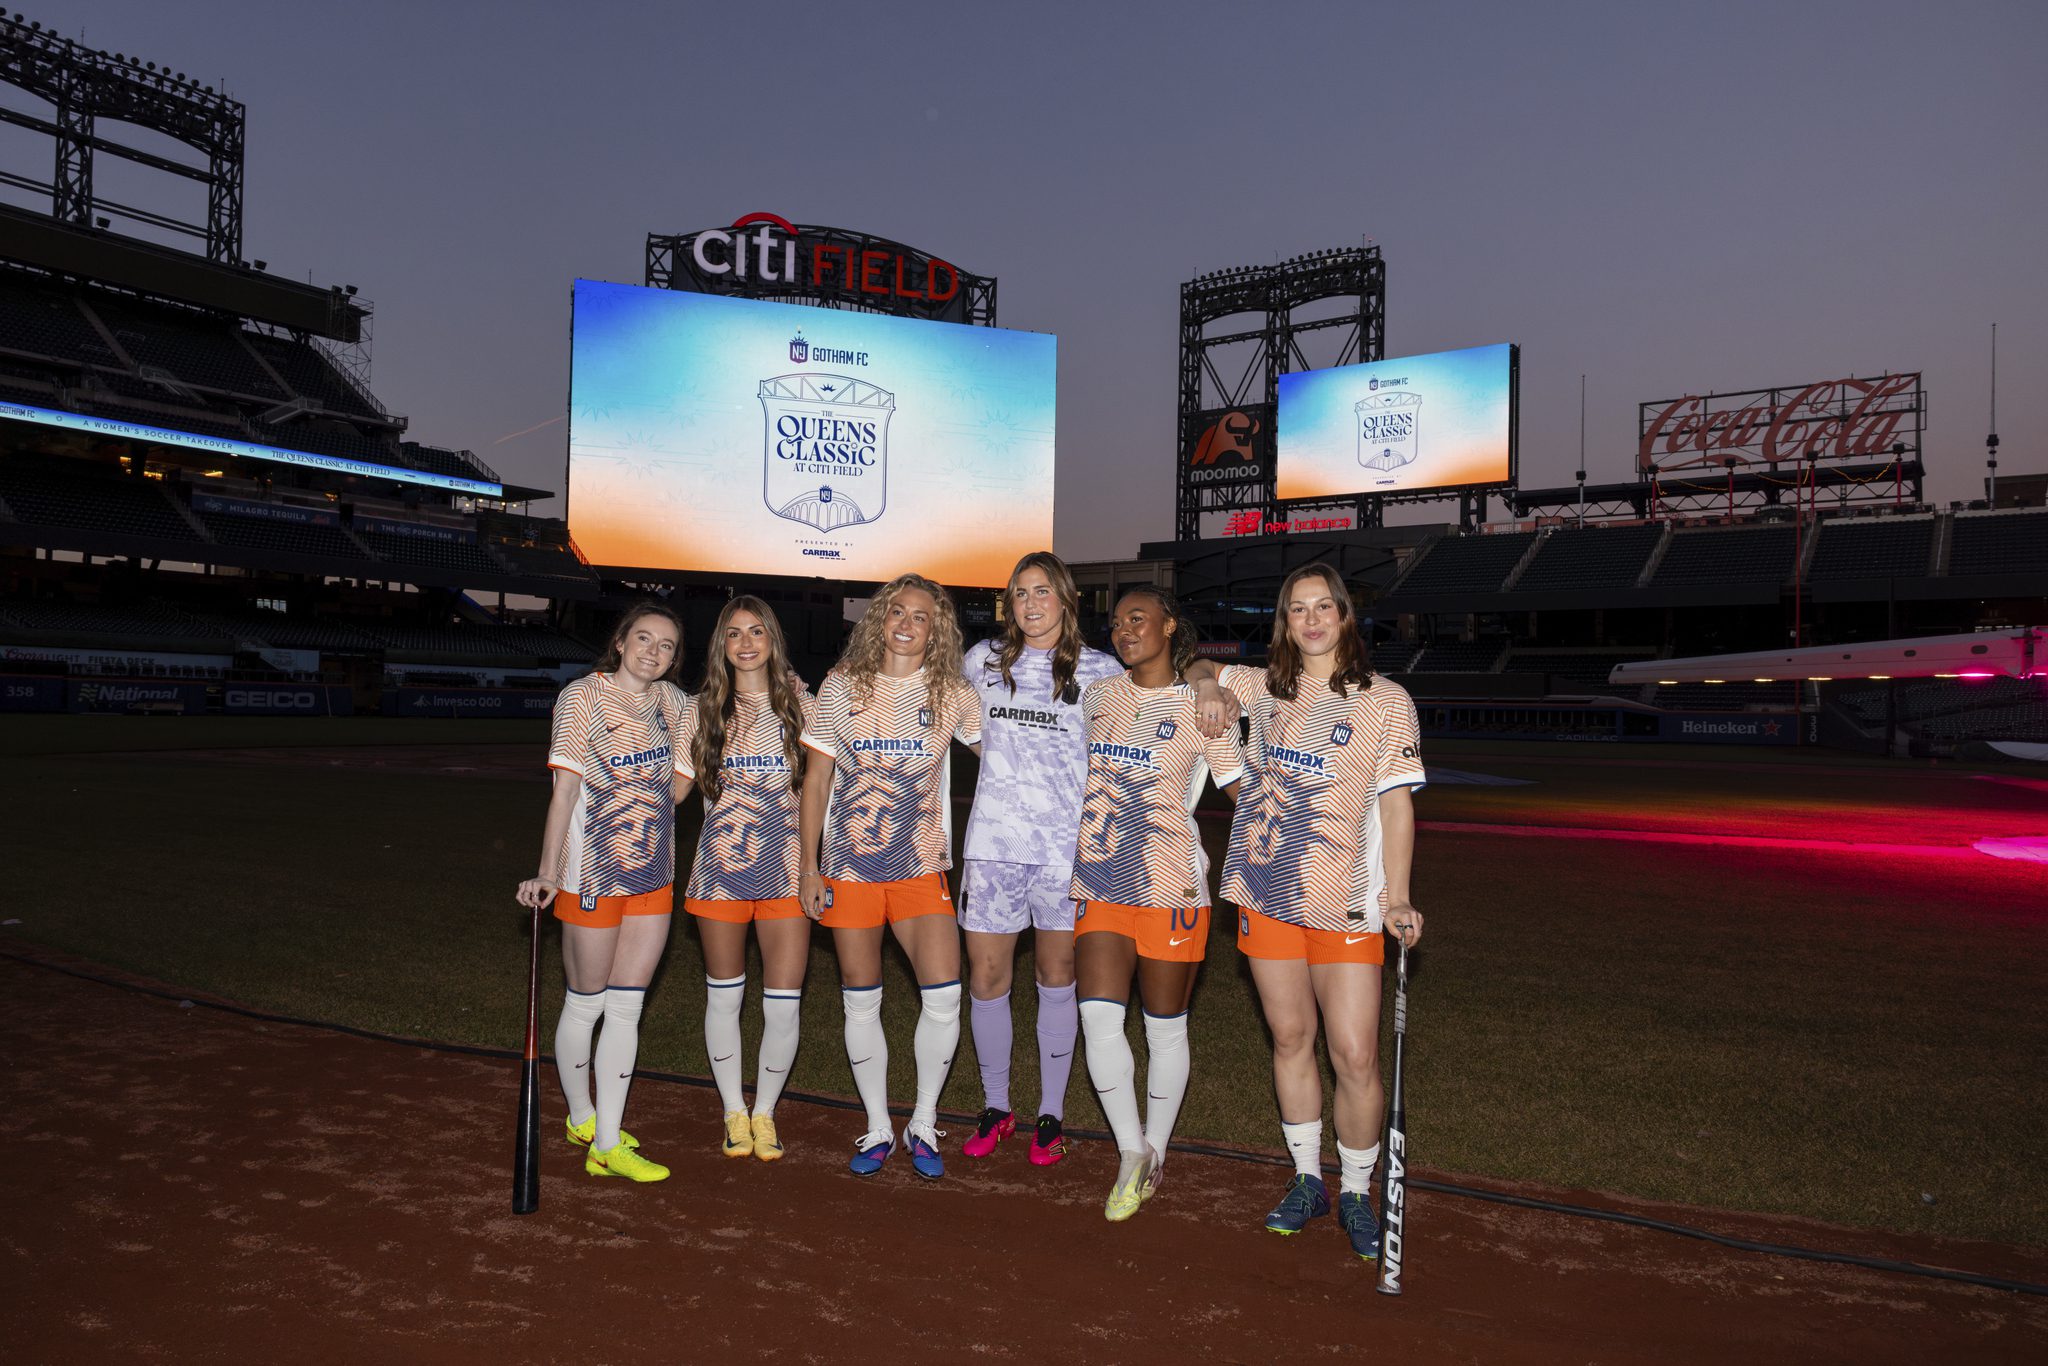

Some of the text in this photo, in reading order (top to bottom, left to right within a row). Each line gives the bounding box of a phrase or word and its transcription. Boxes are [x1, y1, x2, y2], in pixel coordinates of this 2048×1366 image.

[693, 225, 959, 301] citi FIELD
[812, 347, 869, 367] GOTHAM FC
[1380, 377, 1409, 388] GOTHAM FC
[27, 410, 35, 418] FC
[821, 410, 833, 418] THE
[1363, 412, 1412, 430] QUEENS
[94, 421, 140, 435] WOMEN'S
[144, 429, 182, 442] SOCCER
[186, 436, 233, 450] TAKEOVER
[777, 415, 876, 444] QUEENS
[271, 450, 285, 459] THE
[286, 452, 315, 464] QUEENS
[315, 457, 343, 468] CLASSIC
[354, 464, 369, 473] CITI
[370, 466, 391, 476] FIELD
[793, 462, 863, 477] AT CITI FIELD
[1190, 464, 1260, 482] moomoo
[229, 504, 268, 516] MILAGRO
[271, 510, 307, 521] TEQUILA
[381, 524, 395, 533] THE
[1265, 516, 1351, 533] new balance
[88, 655, 122, 665] FIESTA
[127, 656, 155, 666] DECK
[6, 685, 34, 697] 358
[100, 685, 179, 701] National
[224, 689, 316, 709] GEICO
[433, 695, 504, 708] Invesco QQQ
[1681, 720, 1756, 735] Heineken
[1555, 733, 1619, 742] CADILLAC
[1170, 907, 1199, 931] 10
[1383, 1127, 1405, 1290] EASTON
